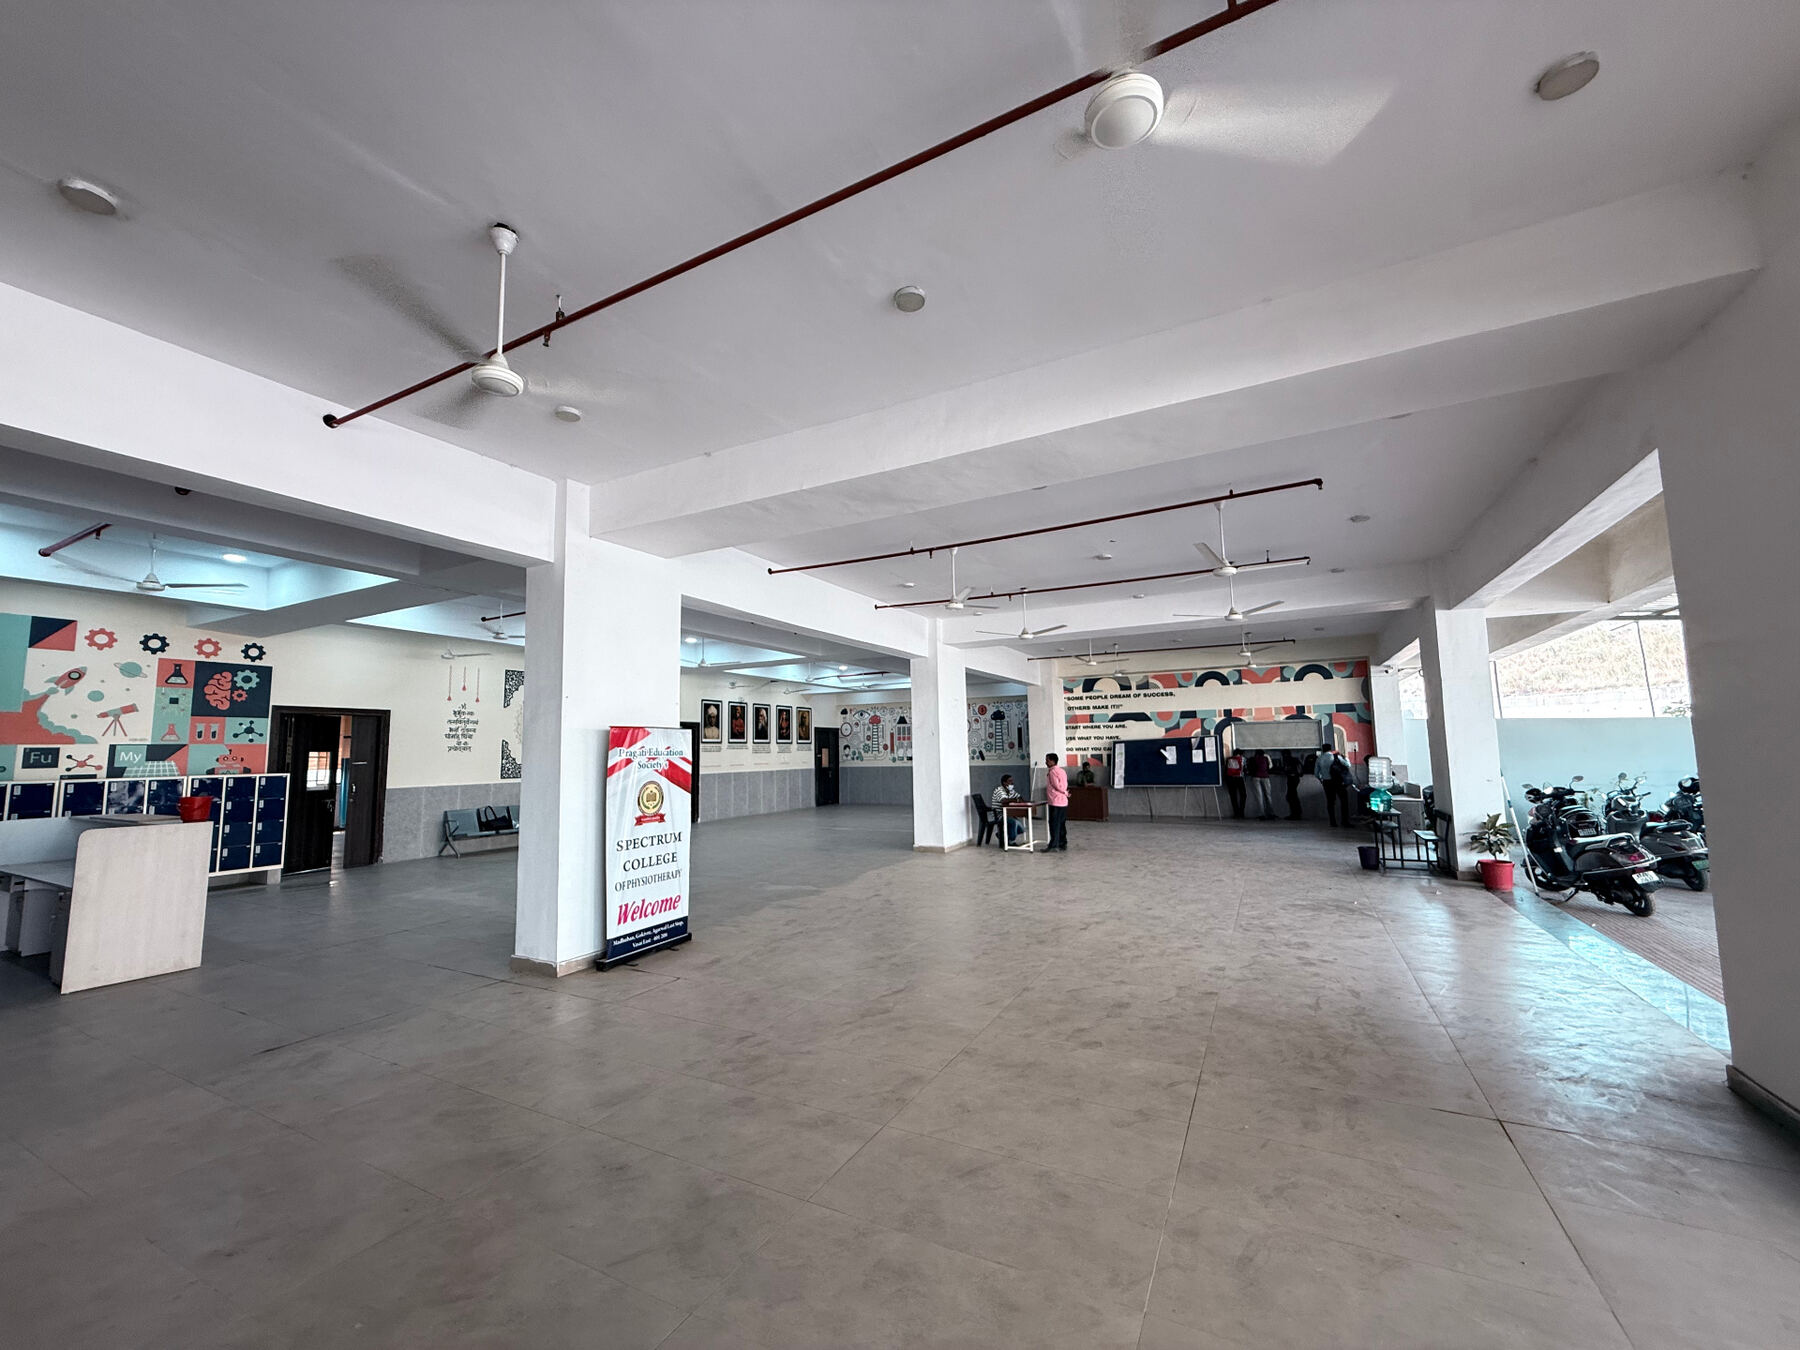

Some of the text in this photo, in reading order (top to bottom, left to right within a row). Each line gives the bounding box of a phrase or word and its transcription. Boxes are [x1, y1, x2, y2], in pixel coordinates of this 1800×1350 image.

[30, 751, 52, 764] Fu
[119, 751, 142, 762] My
[616, 831, 682, 852] SPECTRUM
[623, 852, 678, 872] COLLEGE
[617, 894, 682, 926] Welcome
